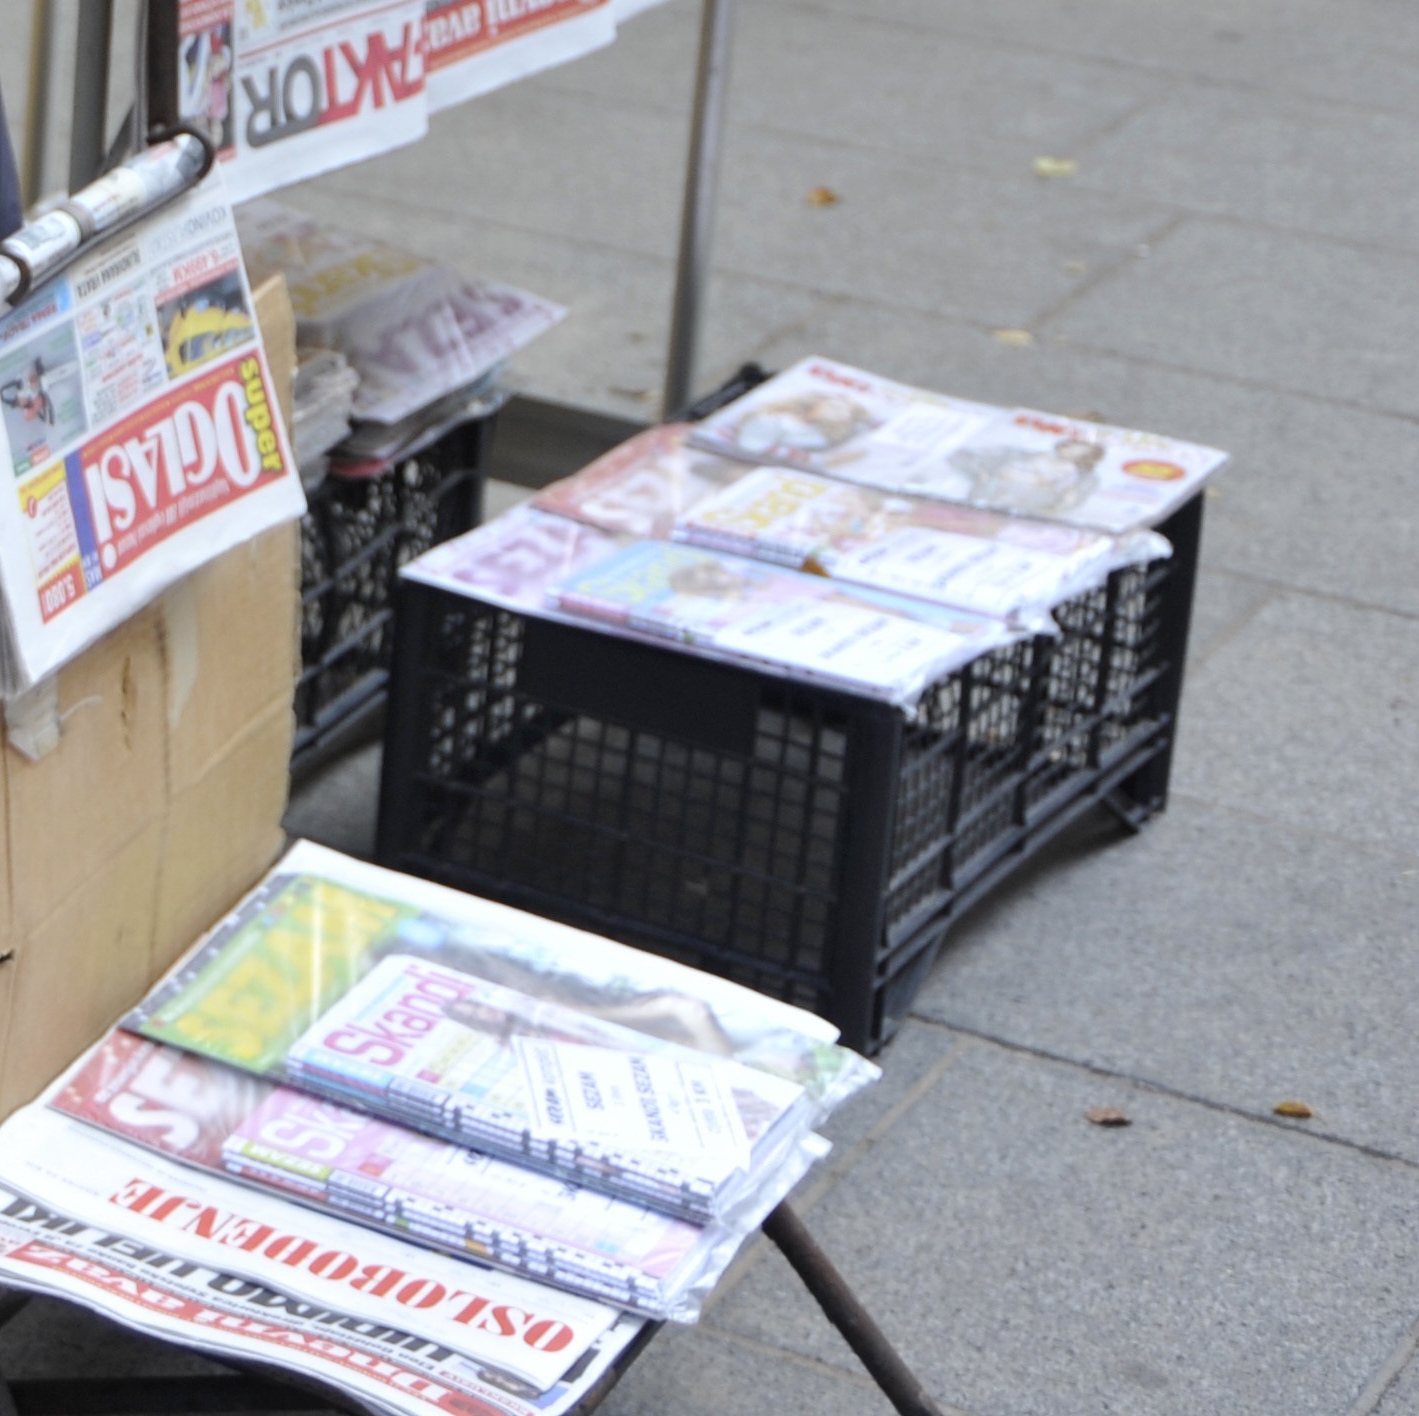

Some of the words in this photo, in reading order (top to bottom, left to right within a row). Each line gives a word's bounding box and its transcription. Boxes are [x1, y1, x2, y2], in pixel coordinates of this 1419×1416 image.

[425, 2, 483, 52] ava
[240, 18, 428, 150] FAKTOR
[240, 356, 281, 472] super
[322, 963, 477, 1068] Skandi
[576, 1070, 606, 1112] SEZAM
[627, 1055, 656, 1098] SEZAM
[23, 1243, 186, 1313] avaz
[192, 1303, 453, 1405] Dnevni
